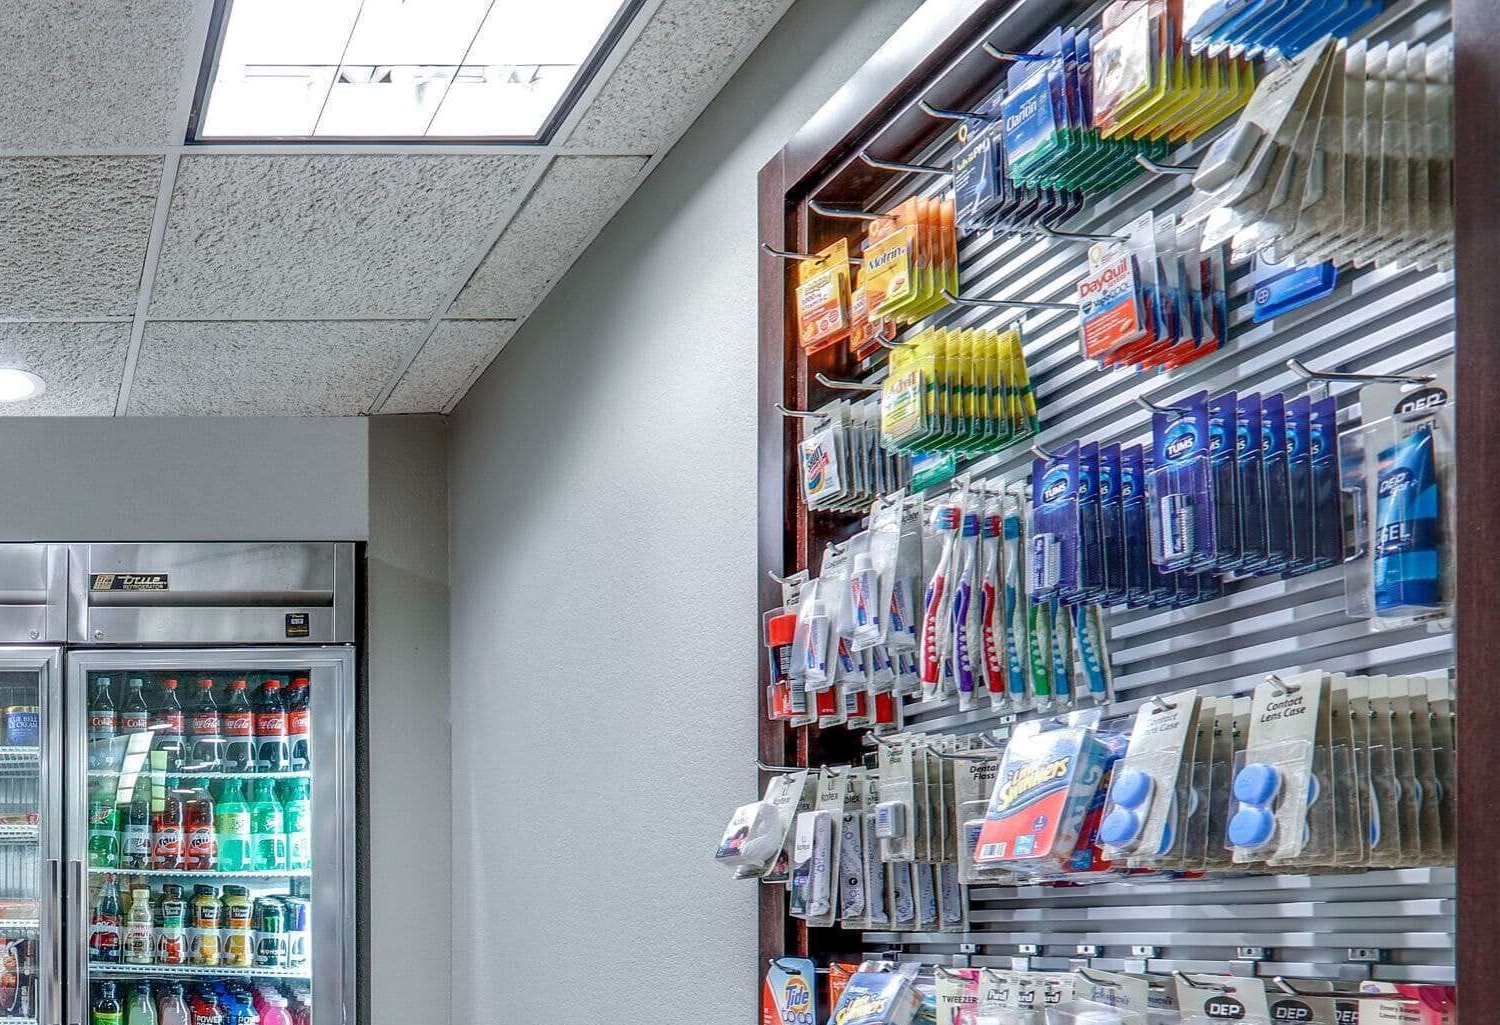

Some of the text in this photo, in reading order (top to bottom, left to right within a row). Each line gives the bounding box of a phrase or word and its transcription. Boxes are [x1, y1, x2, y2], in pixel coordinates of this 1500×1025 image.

[1007, 101, 1037, 131] Claritin
[1080, 257, 1128, 298] DayQuil
[1402, 393, 1441, 414] DEP
[1167, 437, 1194, 456] TUMS
[1043, 481, 1068, 501] TUMS
[1266, 697, 1304, 713] Contact
[1260, 706, 1307, 722] Lens Case
[970, 765, 998, 774] Dental
[786, 985, 809, 1010] Tide
[942, 995, 978, 1004] TWEEZER
[782, 1007, 796, 1022] to
[1209, 1003, 1240, 1016] DEP
[1276, 1007, 1308, 1020] DEP
[197, 1016, 222, 1024] POWER
